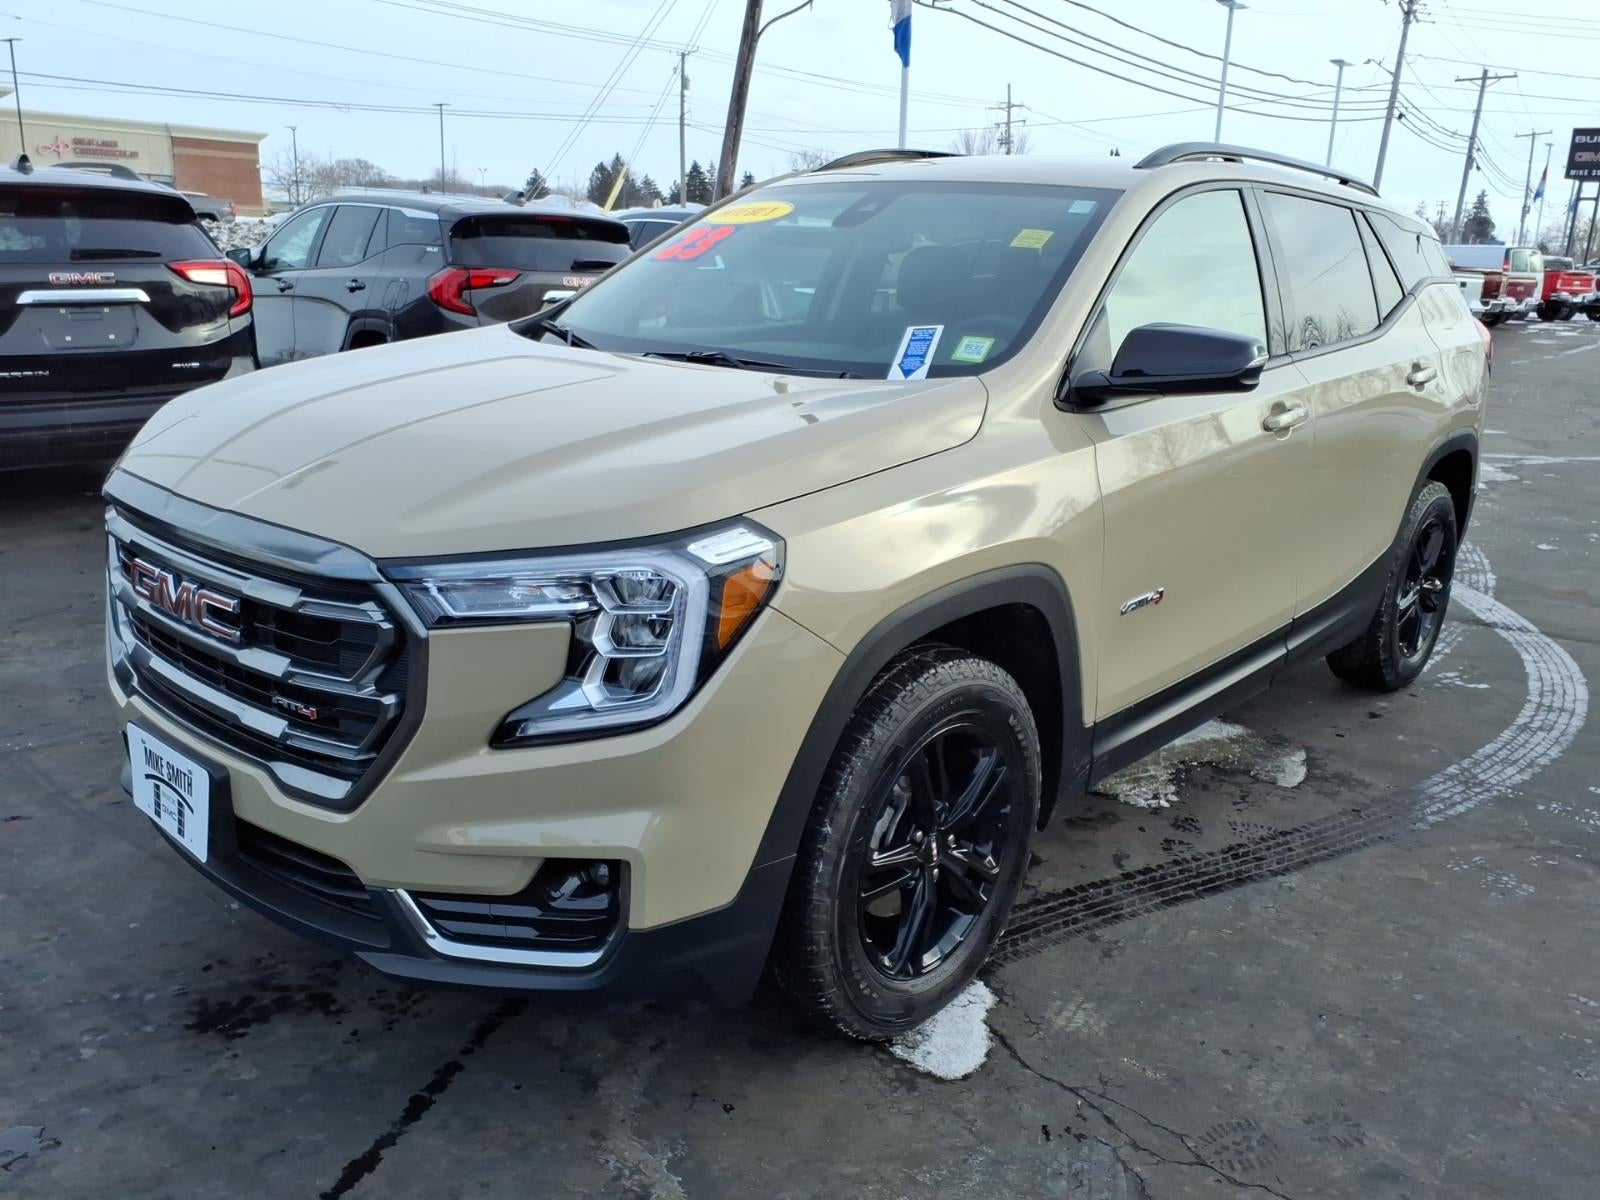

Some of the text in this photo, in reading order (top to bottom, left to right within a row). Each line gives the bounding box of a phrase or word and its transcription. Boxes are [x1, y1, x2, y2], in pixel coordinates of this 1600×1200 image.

[49, 272, 116, 285] GMC
[130, 557, 241, 642] GMC
[143, 745, 164, 778] MIKE
[166, 760, 193, 798] SMITH
